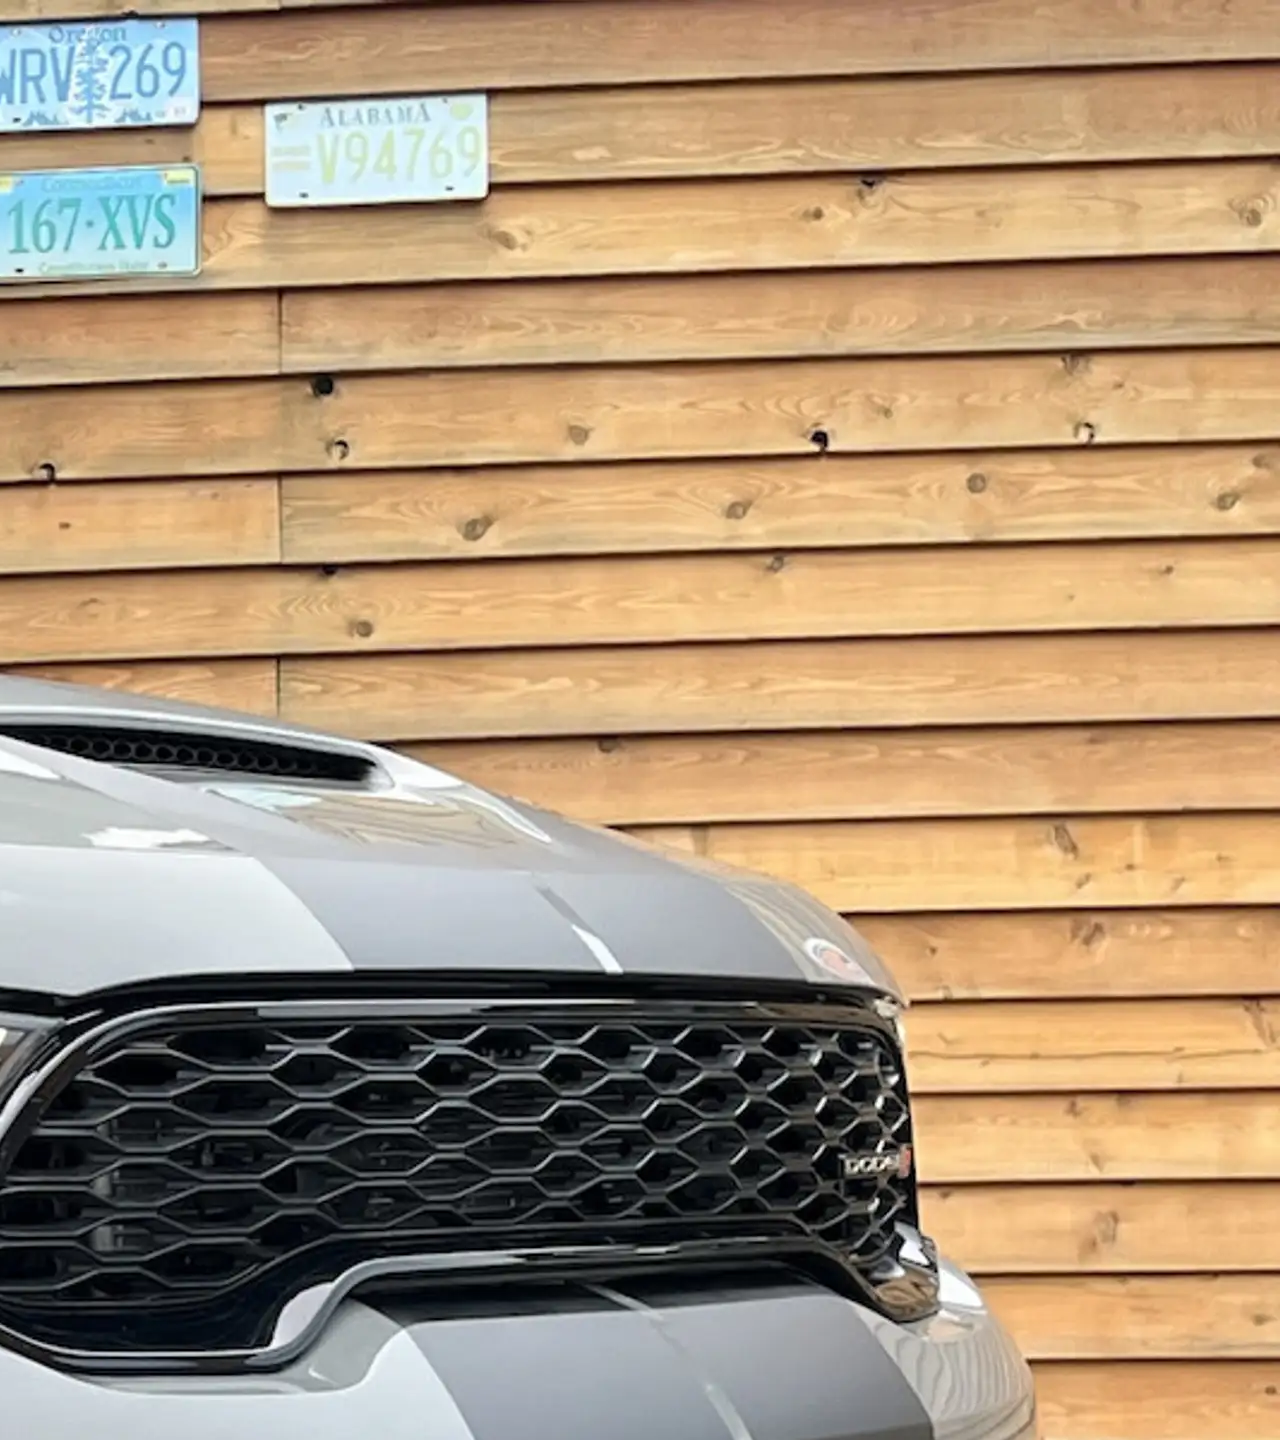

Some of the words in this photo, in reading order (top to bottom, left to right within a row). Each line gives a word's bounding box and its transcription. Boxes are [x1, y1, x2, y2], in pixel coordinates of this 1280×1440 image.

[109, 42, 186, 100] 269
[321, 103, 431, 127] ALABAMA
[317, 126, 481, 184] V94769
